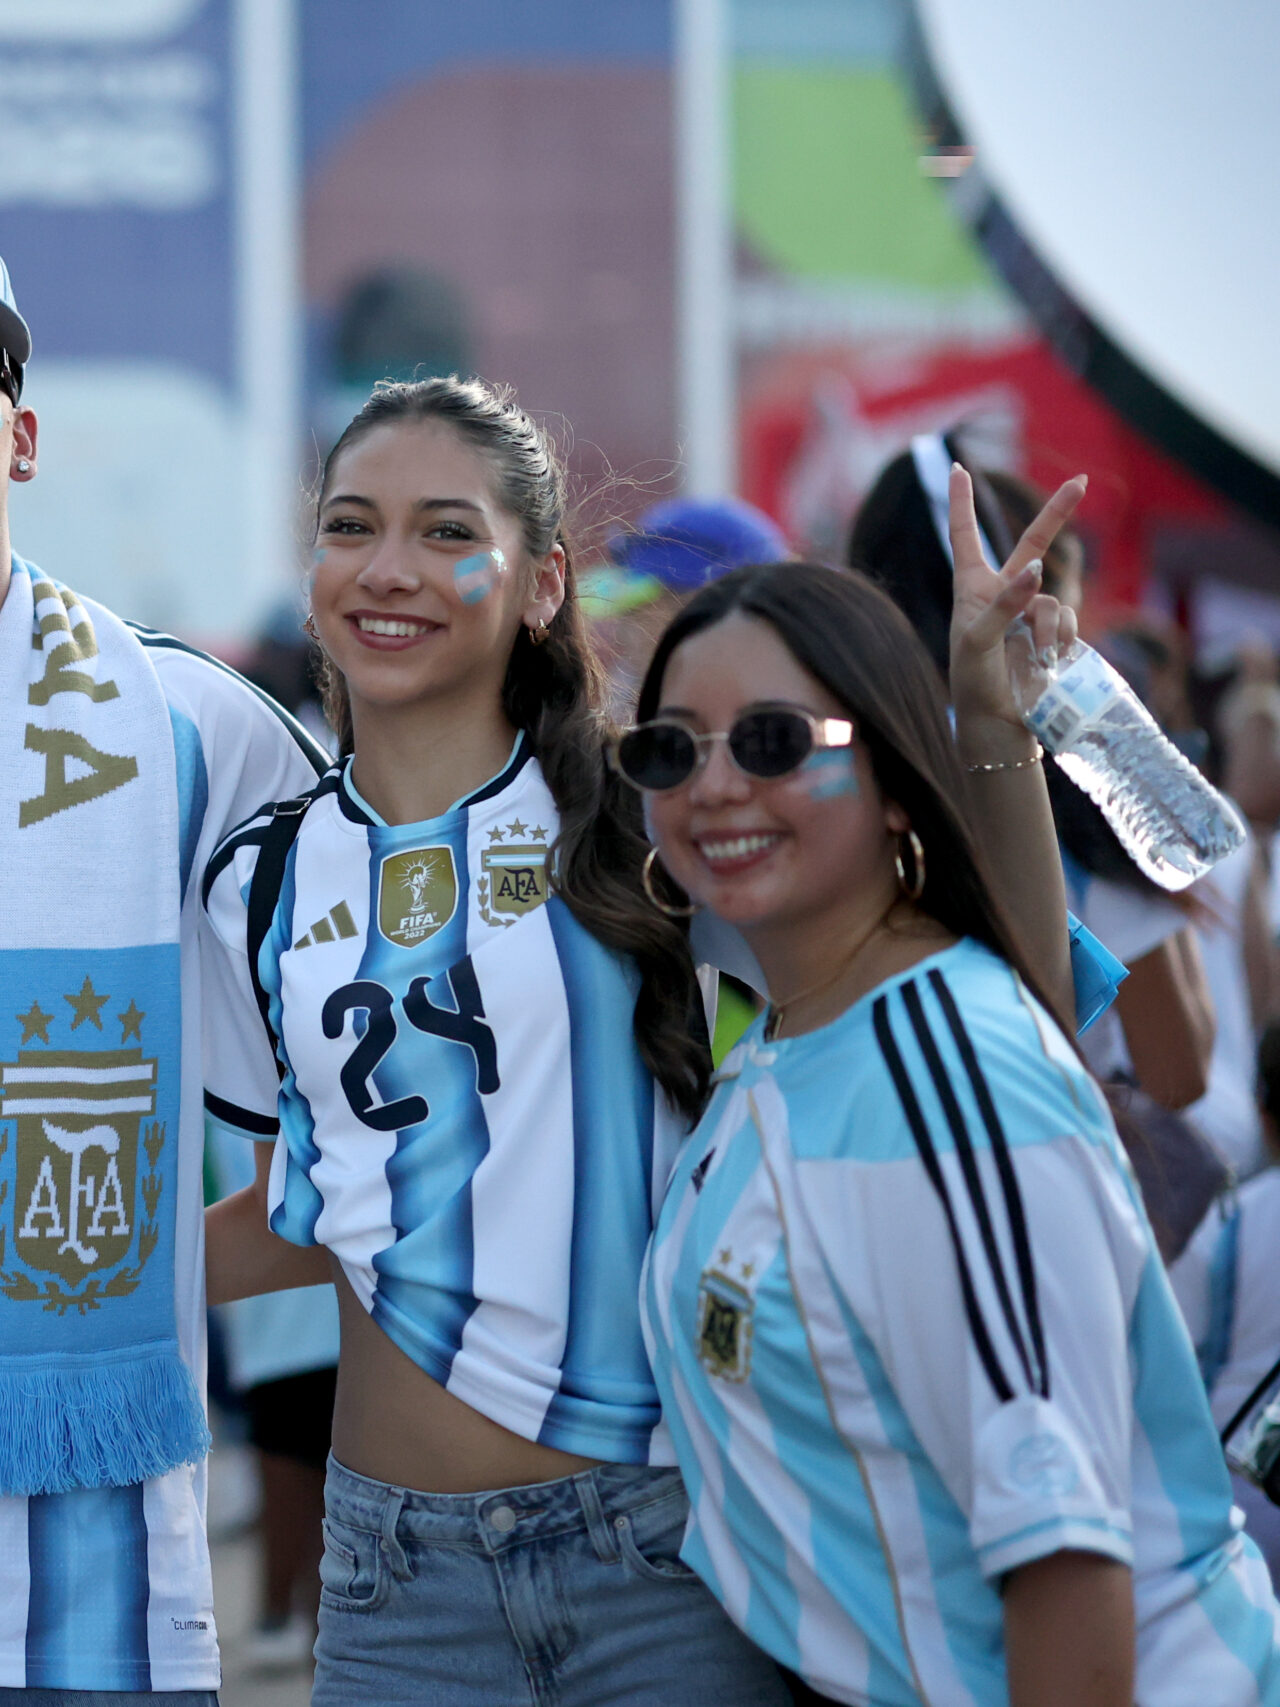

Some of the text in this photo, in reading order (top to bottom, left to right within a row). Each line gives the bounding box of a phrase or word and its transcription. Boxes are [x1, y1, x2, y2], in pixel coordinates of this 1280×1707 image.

[497, 867, 541, 903] AFA
[400, 912, 434, 930] FIFA
[404, 929, 426, 940] 2022
[322, 954, 501, 1132] 24
[18, 1116, 131, 1265] AFA
